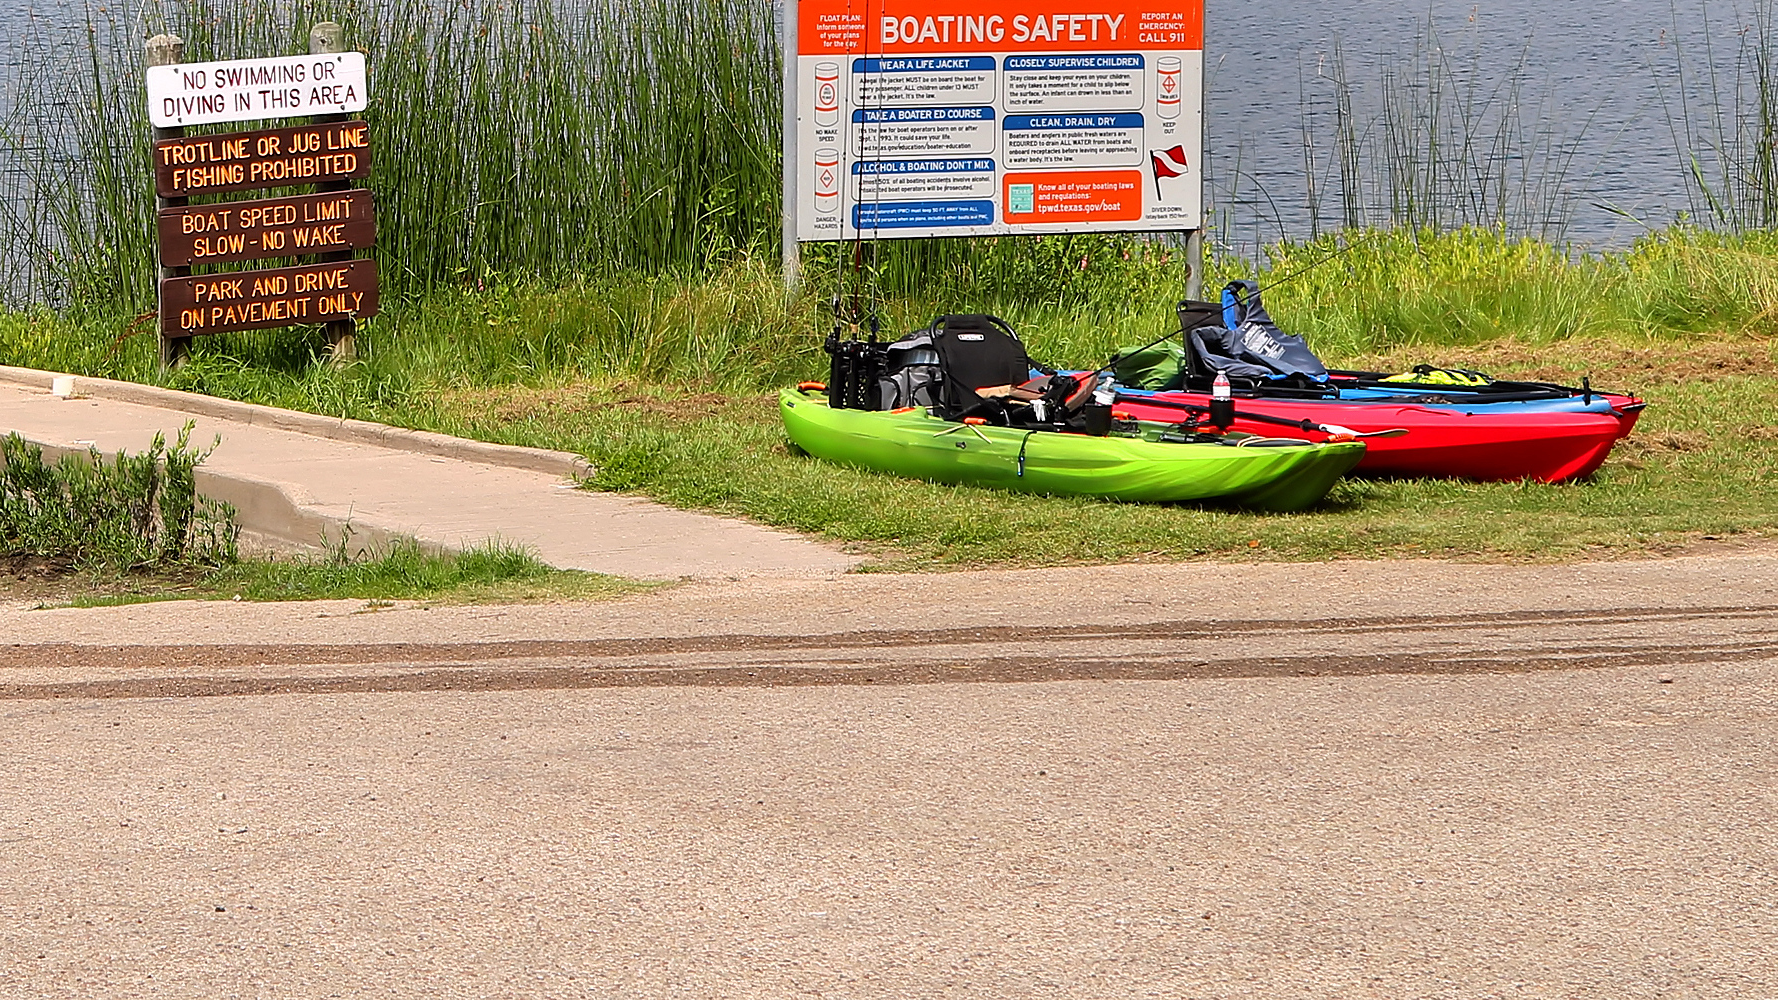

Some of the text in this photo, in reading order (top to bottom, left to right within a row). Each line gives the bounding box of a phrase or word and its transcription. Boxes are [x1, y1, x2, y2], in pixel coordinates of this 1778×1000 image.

[881, 13, 1124, 44] BOATING SAFETY
[1139, 33, 1184, 42] CALL 911
[879, 60, 969, 70] WEAR A LIFE JACKET
[1010, 58, 1139, 67] CLOSELY SUPERVISE CHILDREN
[183, 61, 335, 90] NO SWIMMING OR
[164, 84, 357, 118] DIVING IN THIS AREA
[866, 109, 982, 120] TAKE A BOATER ED COURSE
[1030, 117, 1116, 127] CLEAN, DRAIN, DRY
[910, 126, 936, 134] operators
[159, 127, 369, 166] TROTLINE OR JUG LINE
[173, 153, 357, 190] FISHING PROHIBITED
[899, 163, 906, 171] &
[908, 162, 944, 171] BOATING
[946, 161, 972, 170] DON'T
[974, 160, 990, 169] MIX
[1076, 184, 1090, 192] your
[1092, 183, 1117, 191] boating
[1052, 193, 1091, 201] regulations:
[1038, 199, 1120, 214] tpwd.texas.gov/boat
[182, 198, 354, 235] BOAT SPEED LIMIT
[193, 234, 246, 258] SLOW
[262, 230, 285, 252] NO
[294, 224, 346, 248] WAKE
[195, 268, 349, 303] PARK AND DRIVE
[180, 291, 364, 330] ON PAVEMENT ONLY
